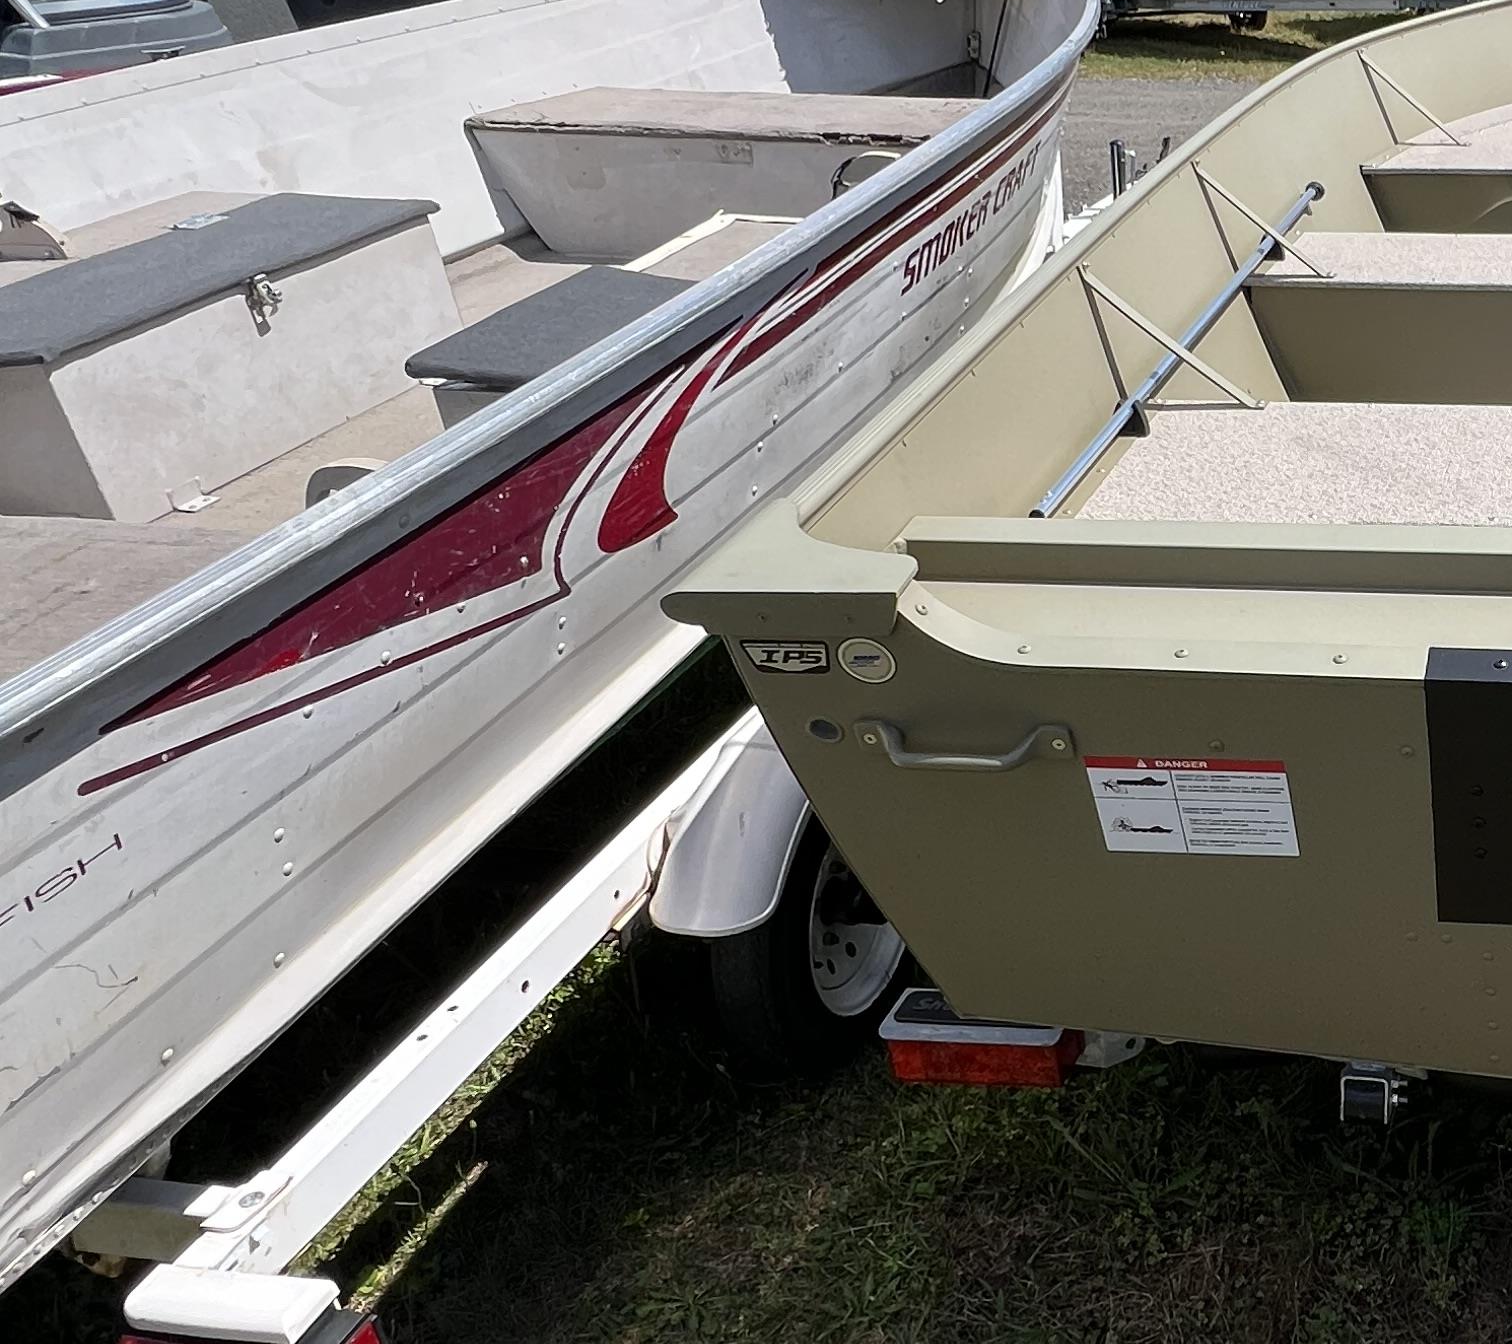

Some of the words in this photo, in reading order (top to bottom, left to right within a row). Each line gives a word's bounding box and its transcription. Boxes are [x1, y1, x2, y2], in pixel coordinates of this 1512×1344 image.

[900, 190, 992, 297] SMOKER
[992, 140, 1042, 216] CRAFT
[759, 649, 824, 665] IPS
[1154, 760, 1209, 770] DANGER
